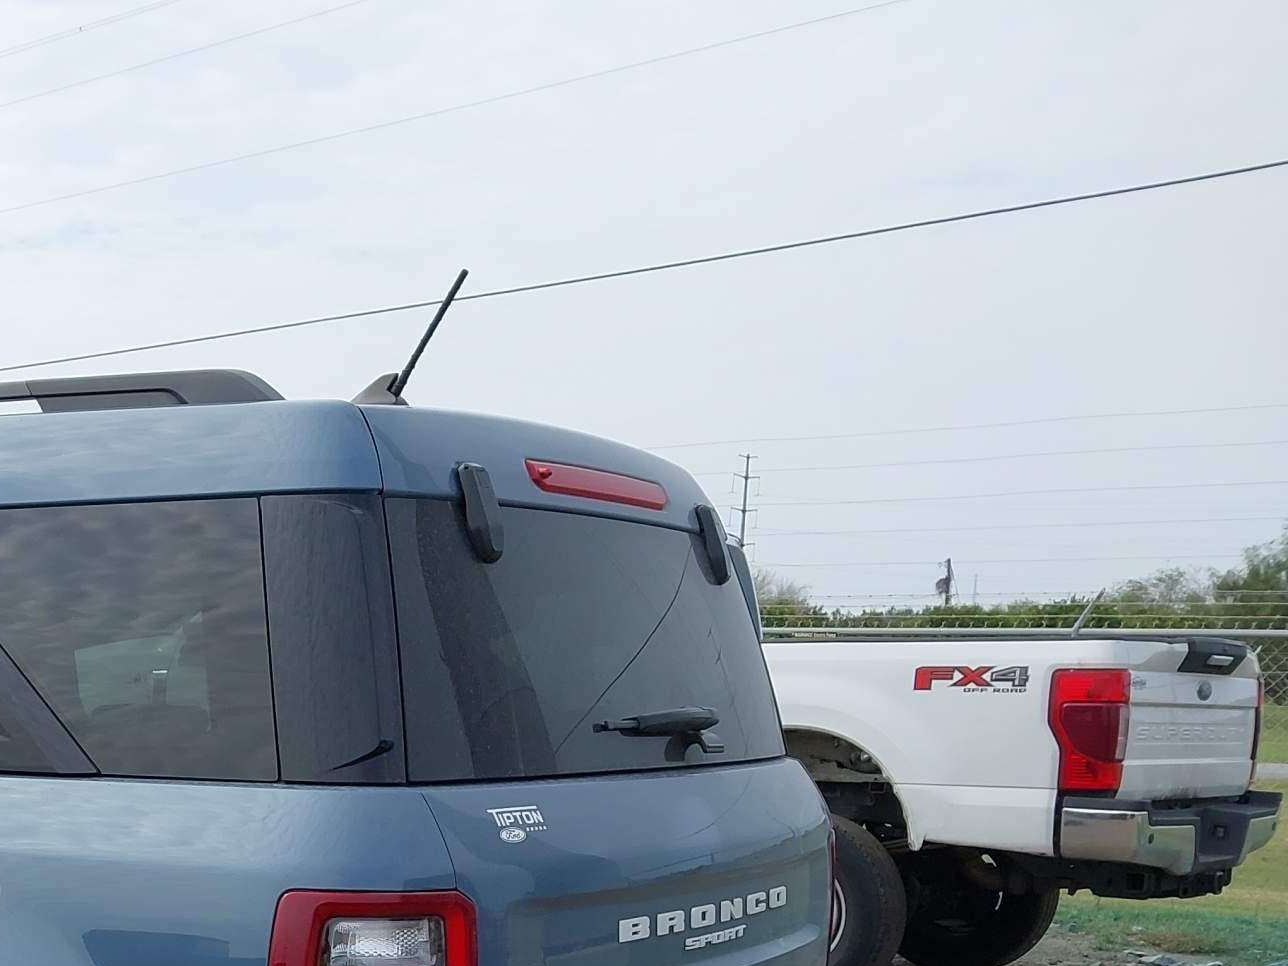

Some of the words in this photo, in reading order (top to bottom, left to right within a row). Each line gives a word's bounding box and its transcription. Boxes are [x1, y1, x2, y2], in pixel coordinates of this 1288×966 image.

[912, 665, 1030, 691] FX4
[486, 805, 544, 827] TIPTON
[618, 885, 787, 944] BRONCO
[684, 923, 747, 951] SPORT
